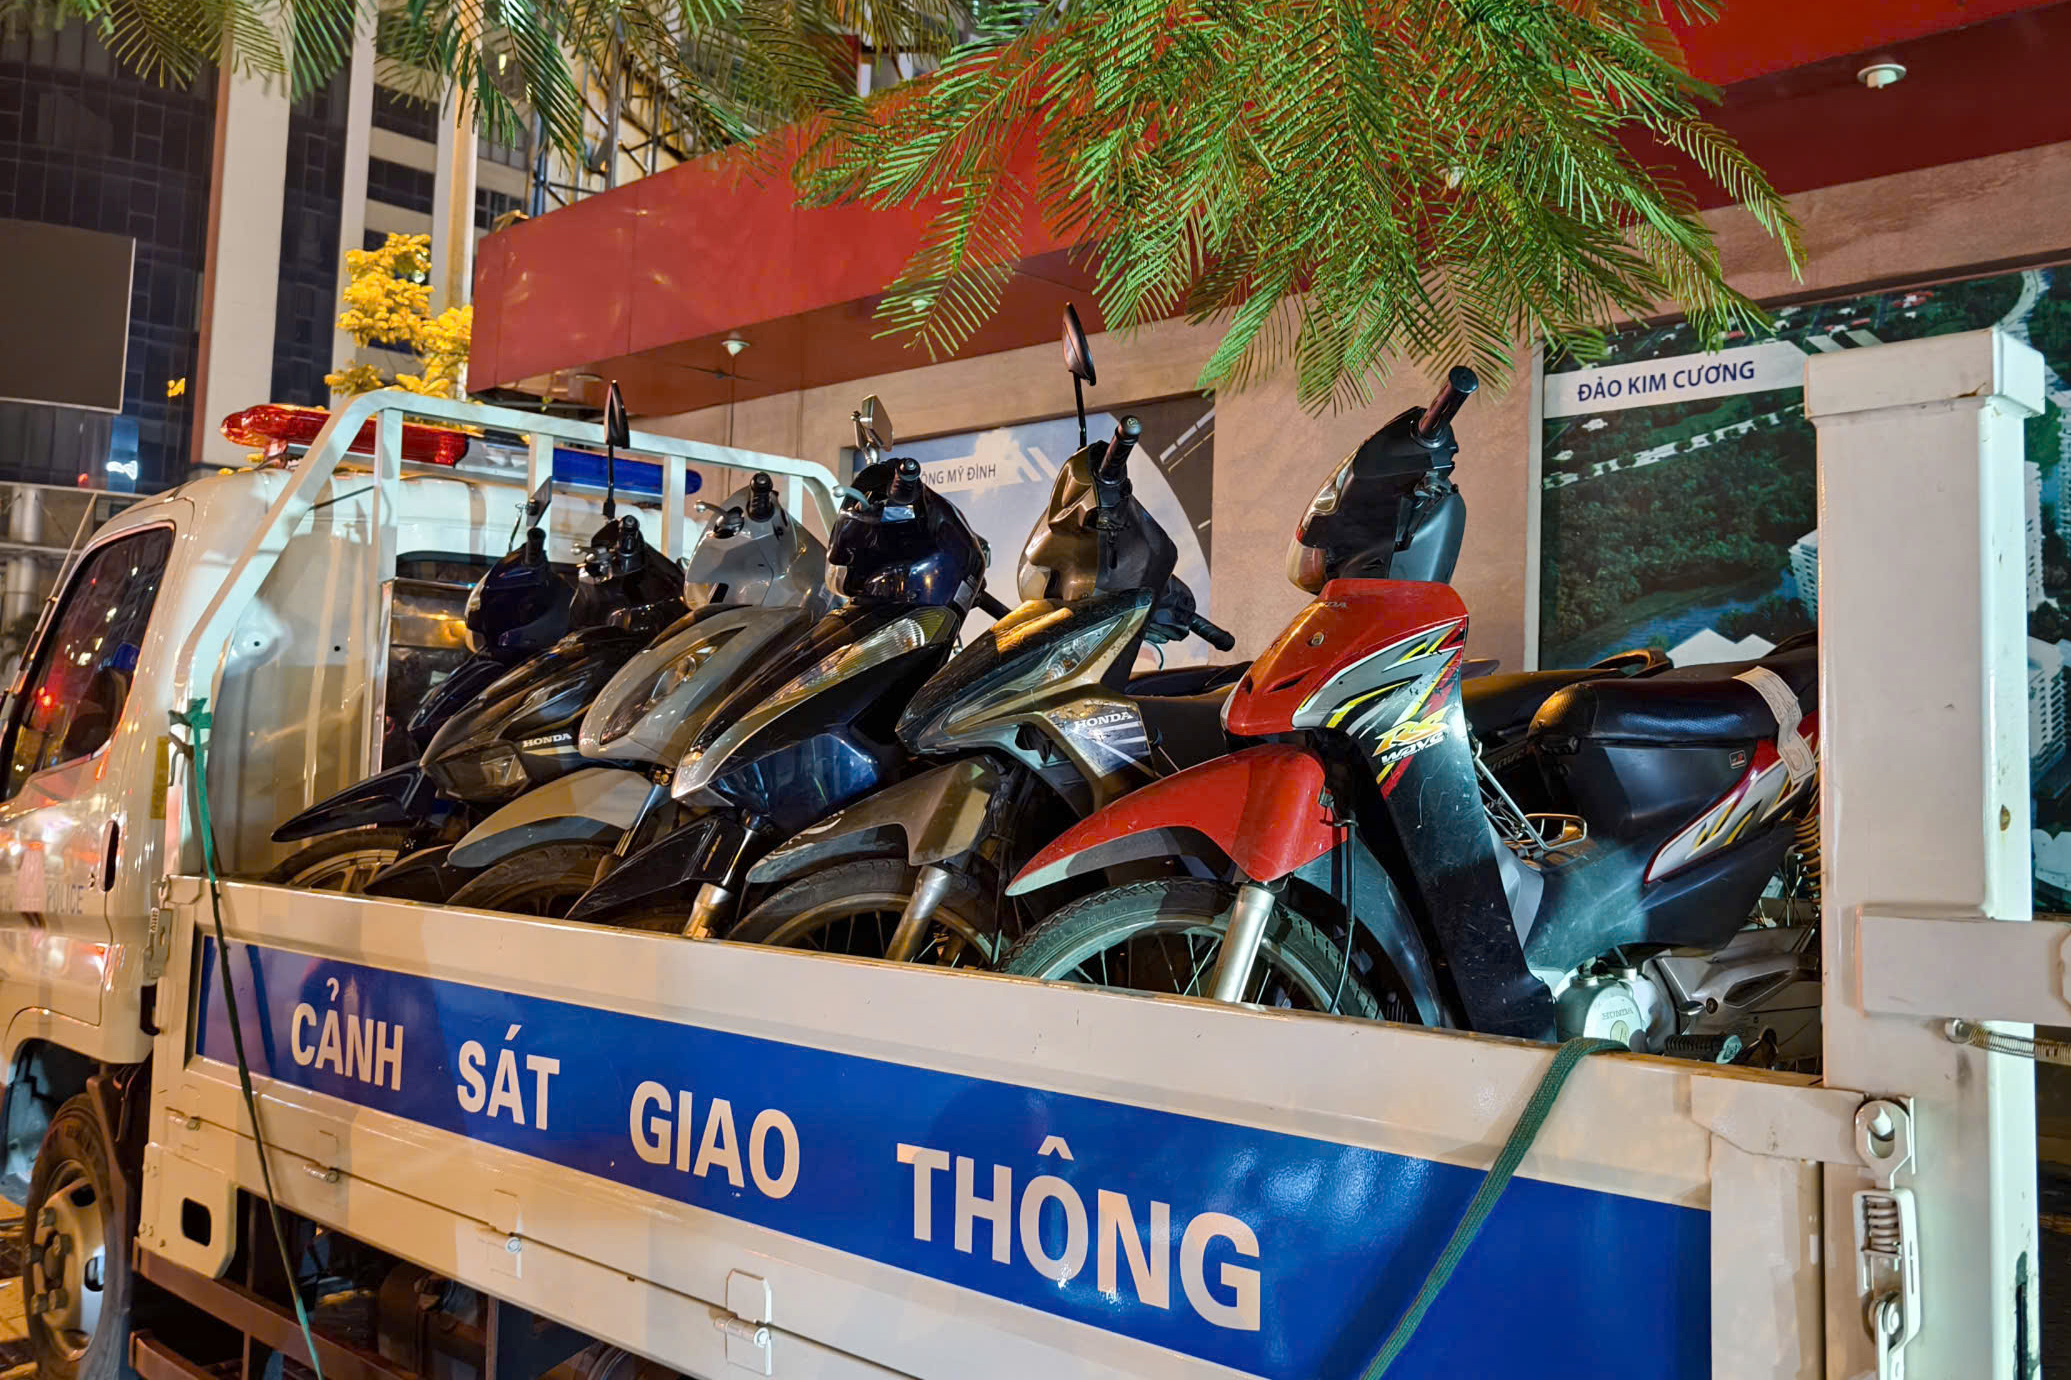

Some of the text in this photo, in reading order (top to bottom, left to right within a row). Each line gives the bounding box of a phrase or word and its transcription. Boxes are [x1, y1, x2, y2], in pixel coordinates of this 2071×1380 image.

[1578, 361, 1755, 402] ĐẢO KIM CƯƠNG
[967, 463, 996, 480] ĐÌNH
[1073, 711, 1134, 730] HONDA
[523, 733, 572, 748] HONDA
[46, 883, 84, 915] POLICE
[1602, 1008, 1633, 1019] HONDA
[291, 977, 1260, 1331] CẢNH SÁT GIAO THÔNG
